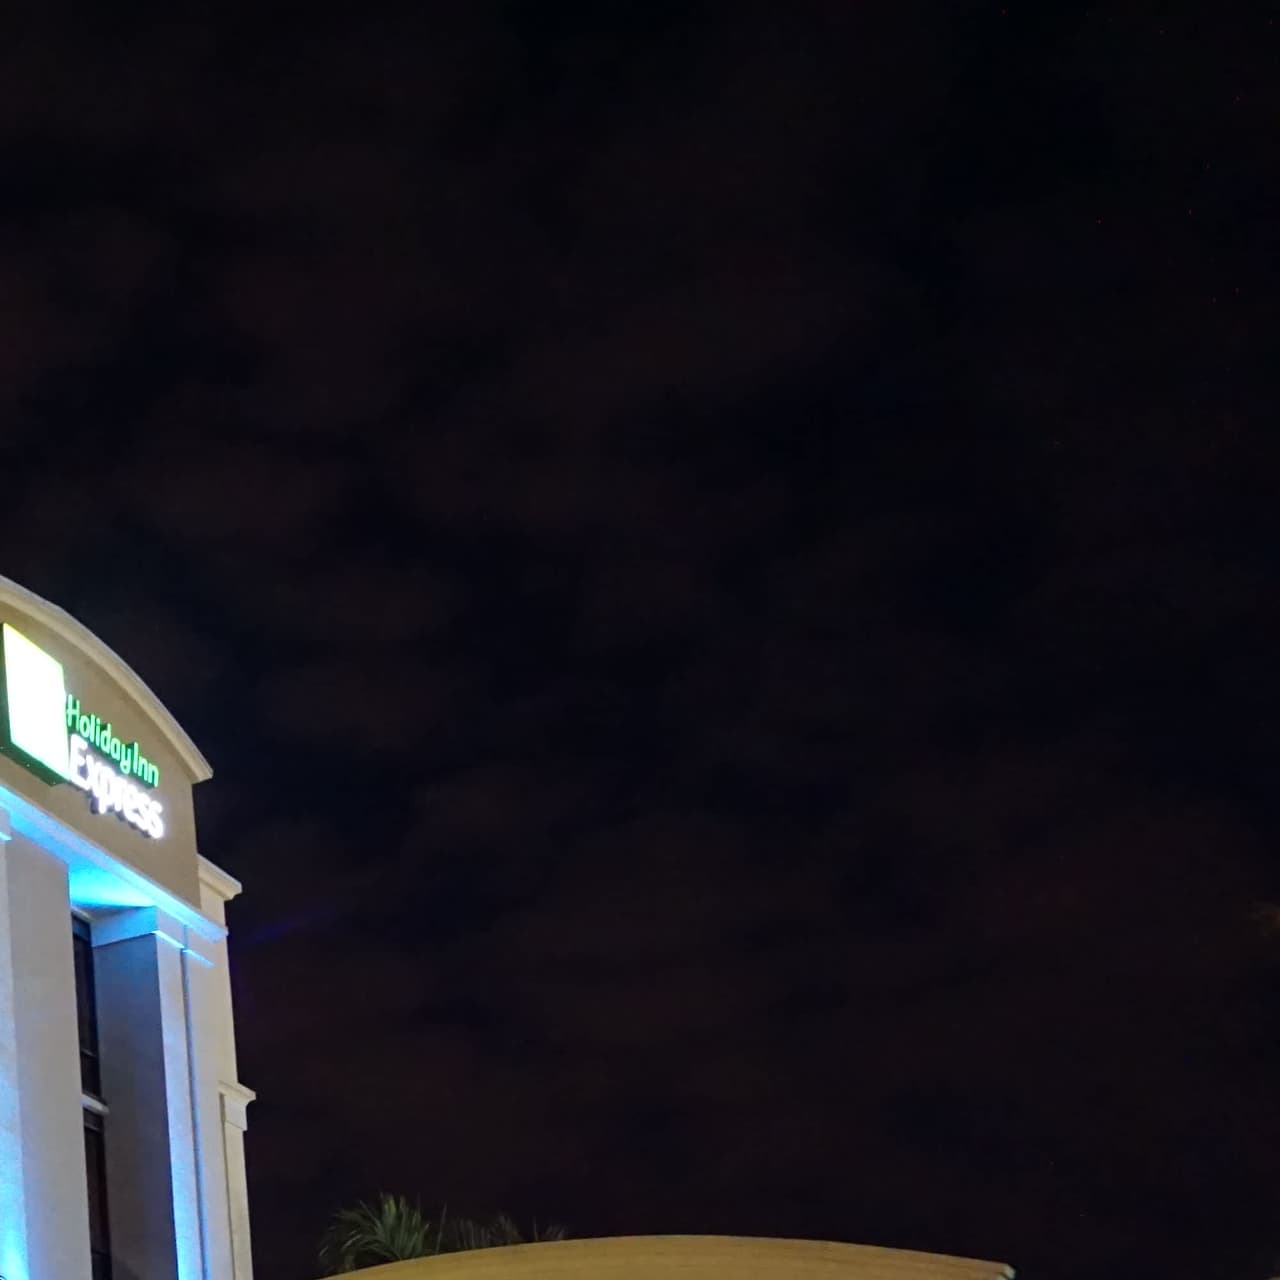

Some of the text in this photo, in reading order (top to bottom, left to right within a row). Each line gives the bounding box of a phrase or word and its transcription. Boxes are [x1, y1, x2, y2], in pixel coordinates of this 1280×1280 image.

[67, 694, 159, 787] Holiday Inn
[70, 734, 164, 839] Express
